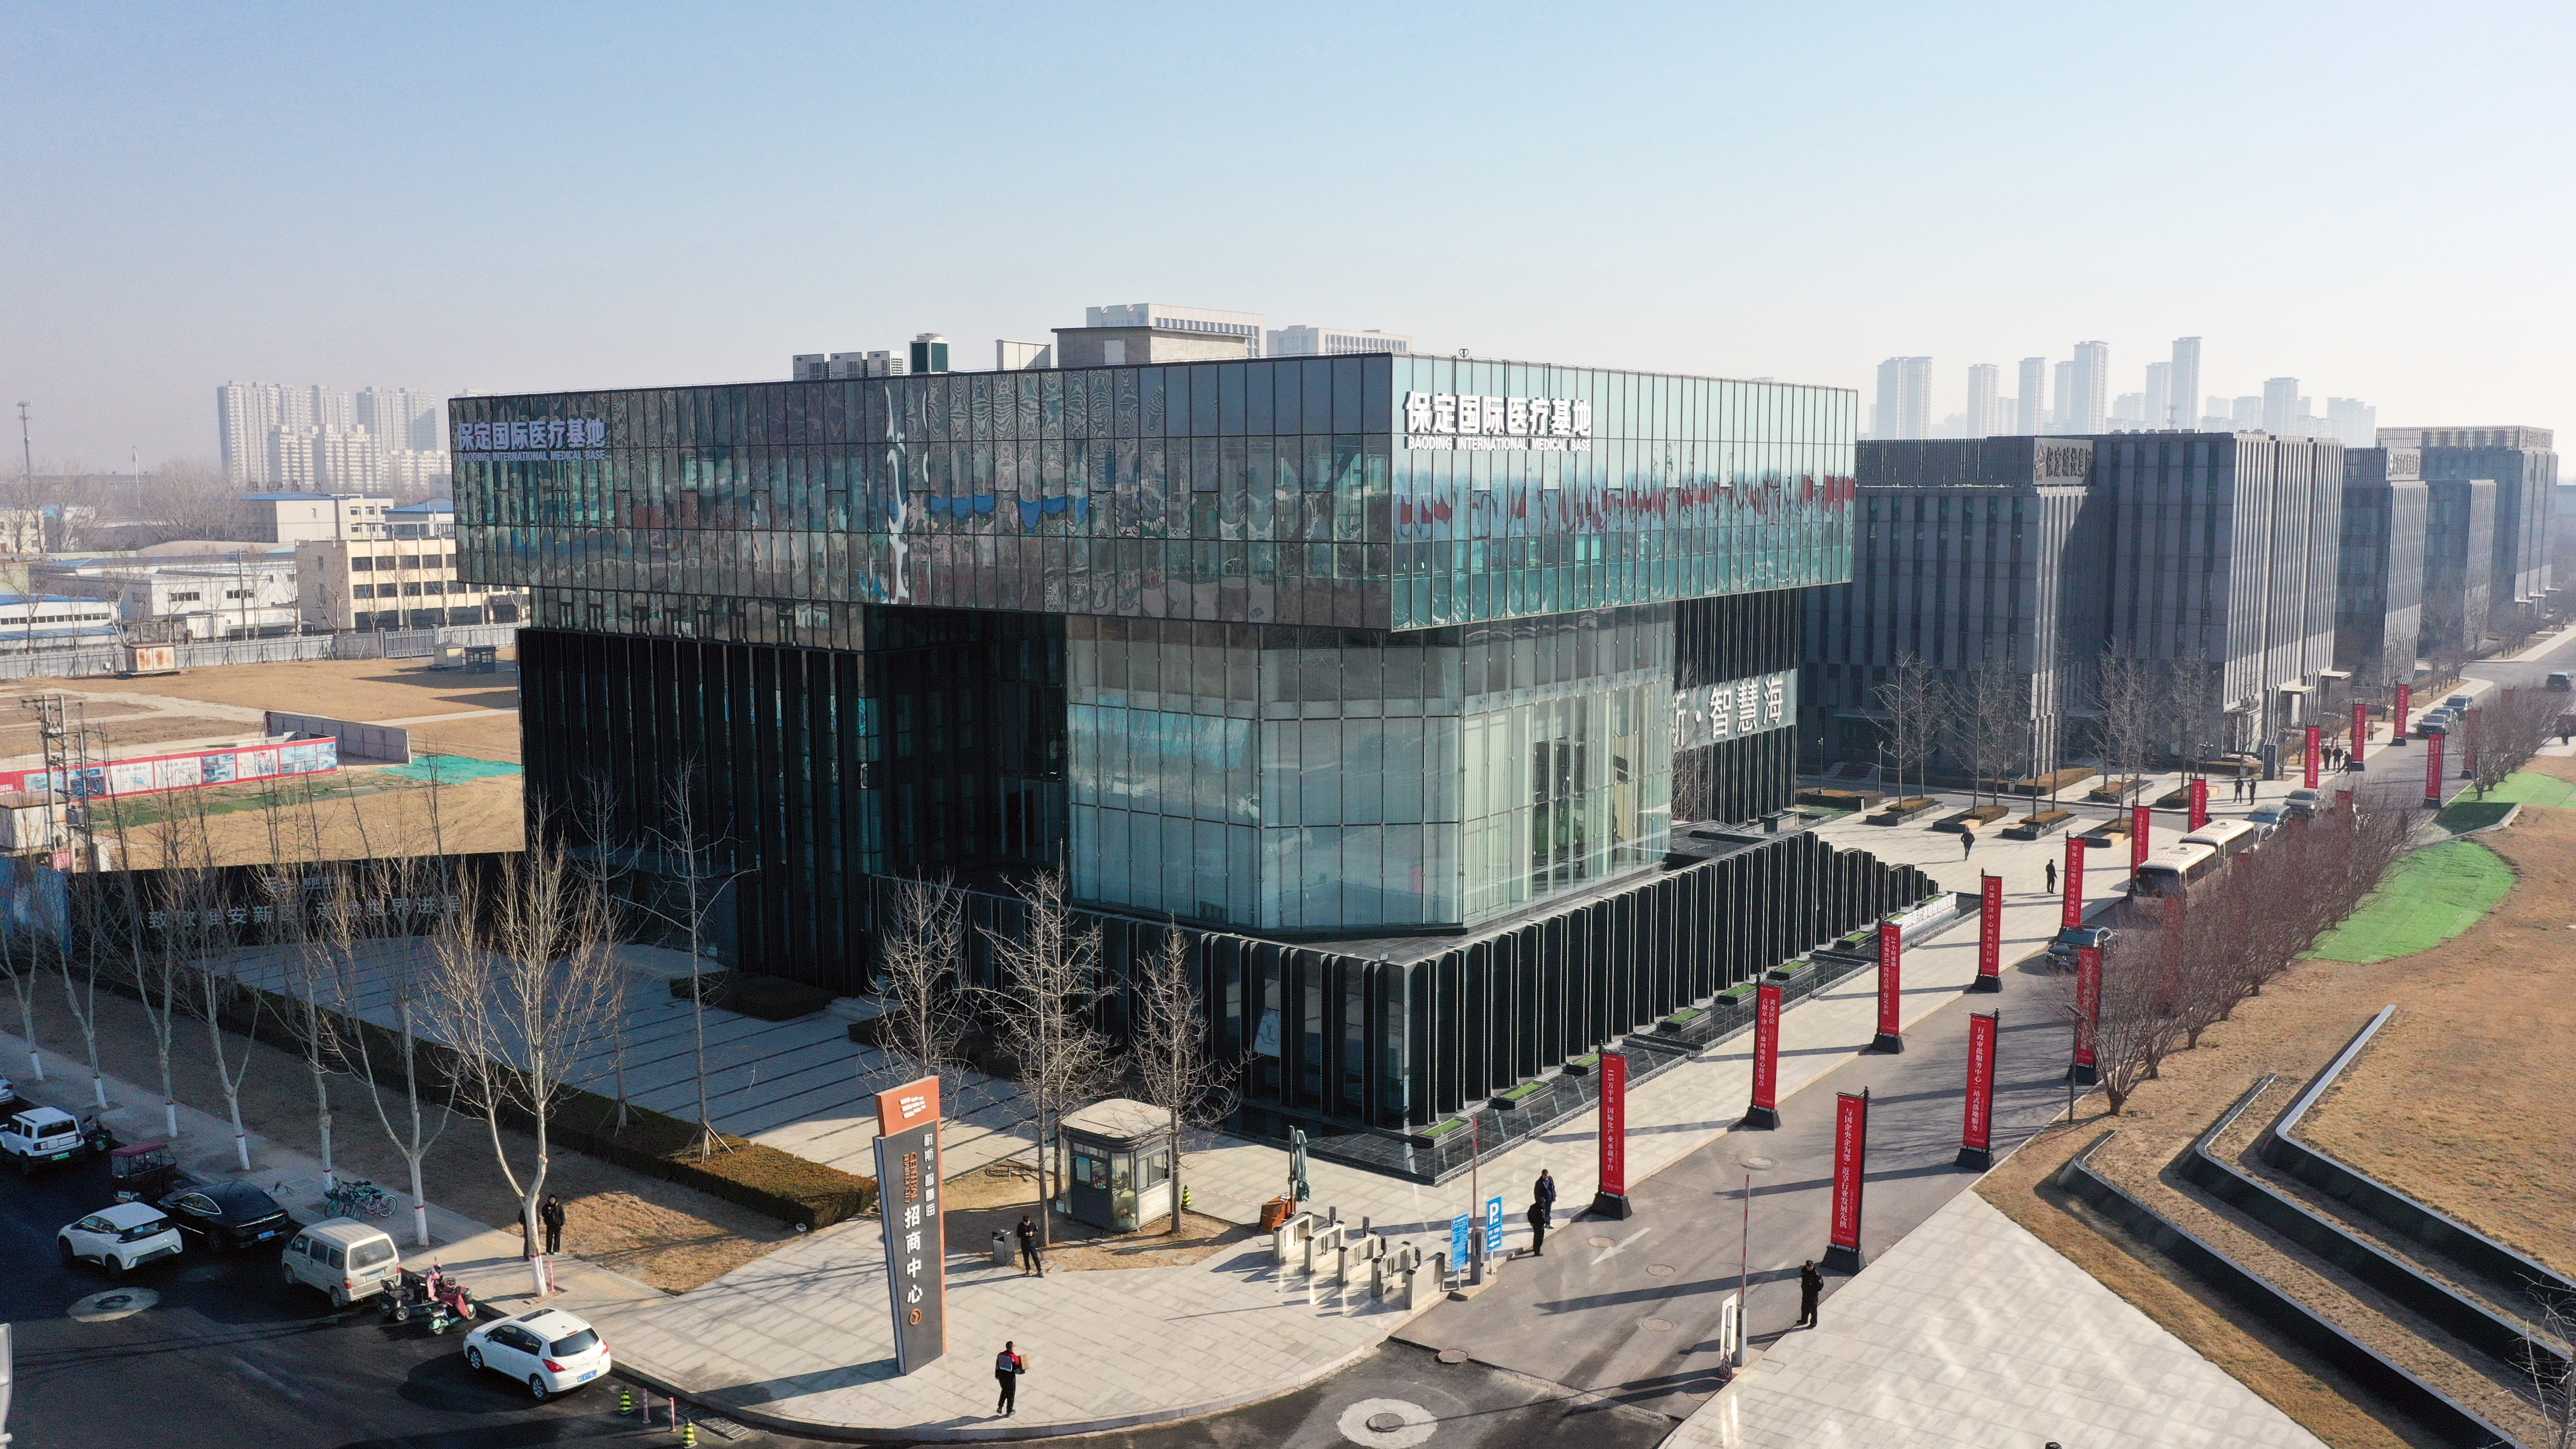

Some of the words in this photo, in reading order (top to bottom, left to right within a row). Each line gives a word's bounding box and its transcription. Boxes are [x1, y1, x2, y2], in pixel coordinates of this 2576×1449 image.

[1402, 391, 1592, 436] 保定国际医疗基地
[458, 418, 606, 450] 保定国际医疗基地
[1405, 435, 1452, 450] BAODING
[1456, 436, 1528, 451] INTERNATIONAL
[1531, 437, 1567, 451] MEDICAL
[1571, 438, 1591, 452] BASE
[459, 451, 490, 462] BAODING
[492, 451, 547, 462] INTERNATIONAL
[550, 450, 583, 461] MEDICAL
[585, 450, 606, 460] BASE
[905, 1177, 910, 1186] OF
[910, 1152, 919, 1203] CENTRAL
[1489, 1202, 1499, 1225] P
[904, 1204, 923, 1304] 招商中心
[1725, 1360, 1730, 1376] 5
